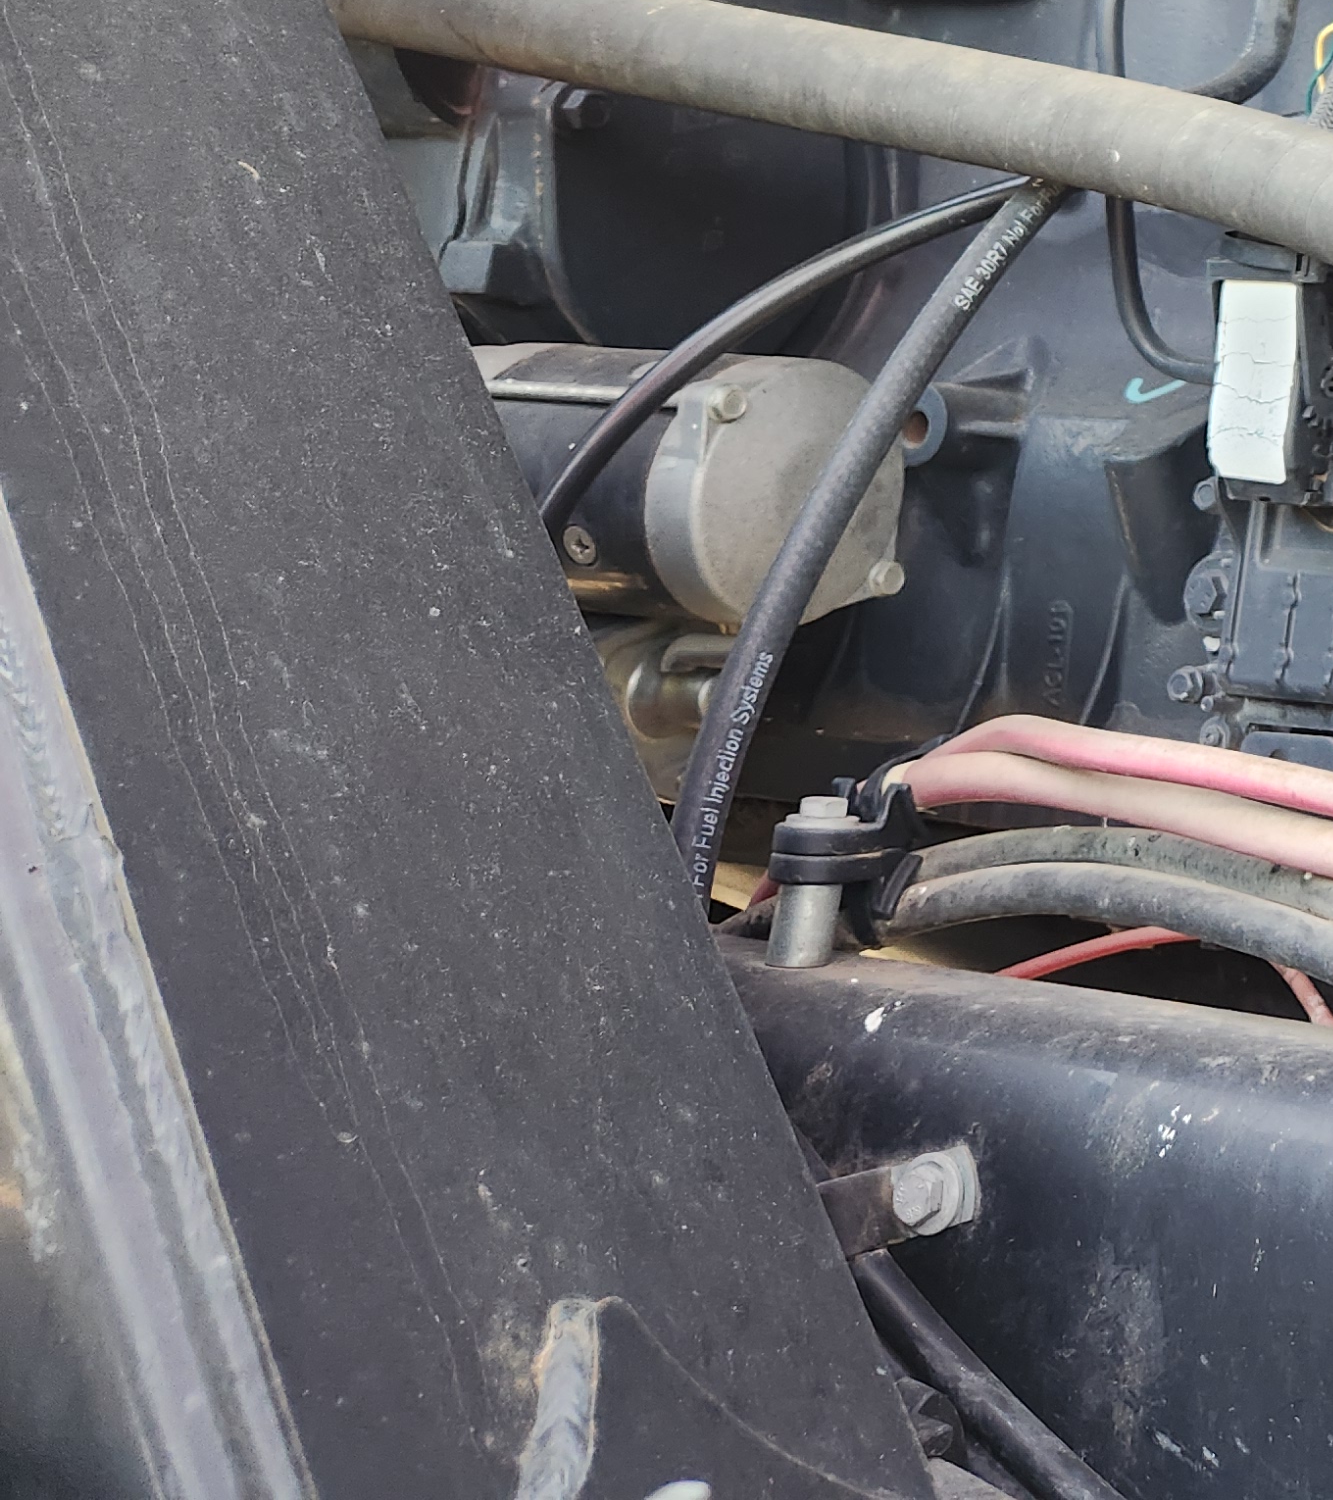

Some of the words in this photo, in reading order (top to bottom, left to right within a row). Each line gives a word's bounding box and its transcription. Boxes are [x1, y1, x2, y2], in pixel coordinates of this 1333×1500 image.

[954, 276, 984, 311] SAE
[975, 240, 1008, 280] 30R7
[1020, 199, 1045, 223] For
[730, 652, 774, 726] Systems
[703, 728, 744, 804] Injection
[693, 807, 720, 850] Fuel
[693, 852, 709, 886] For
